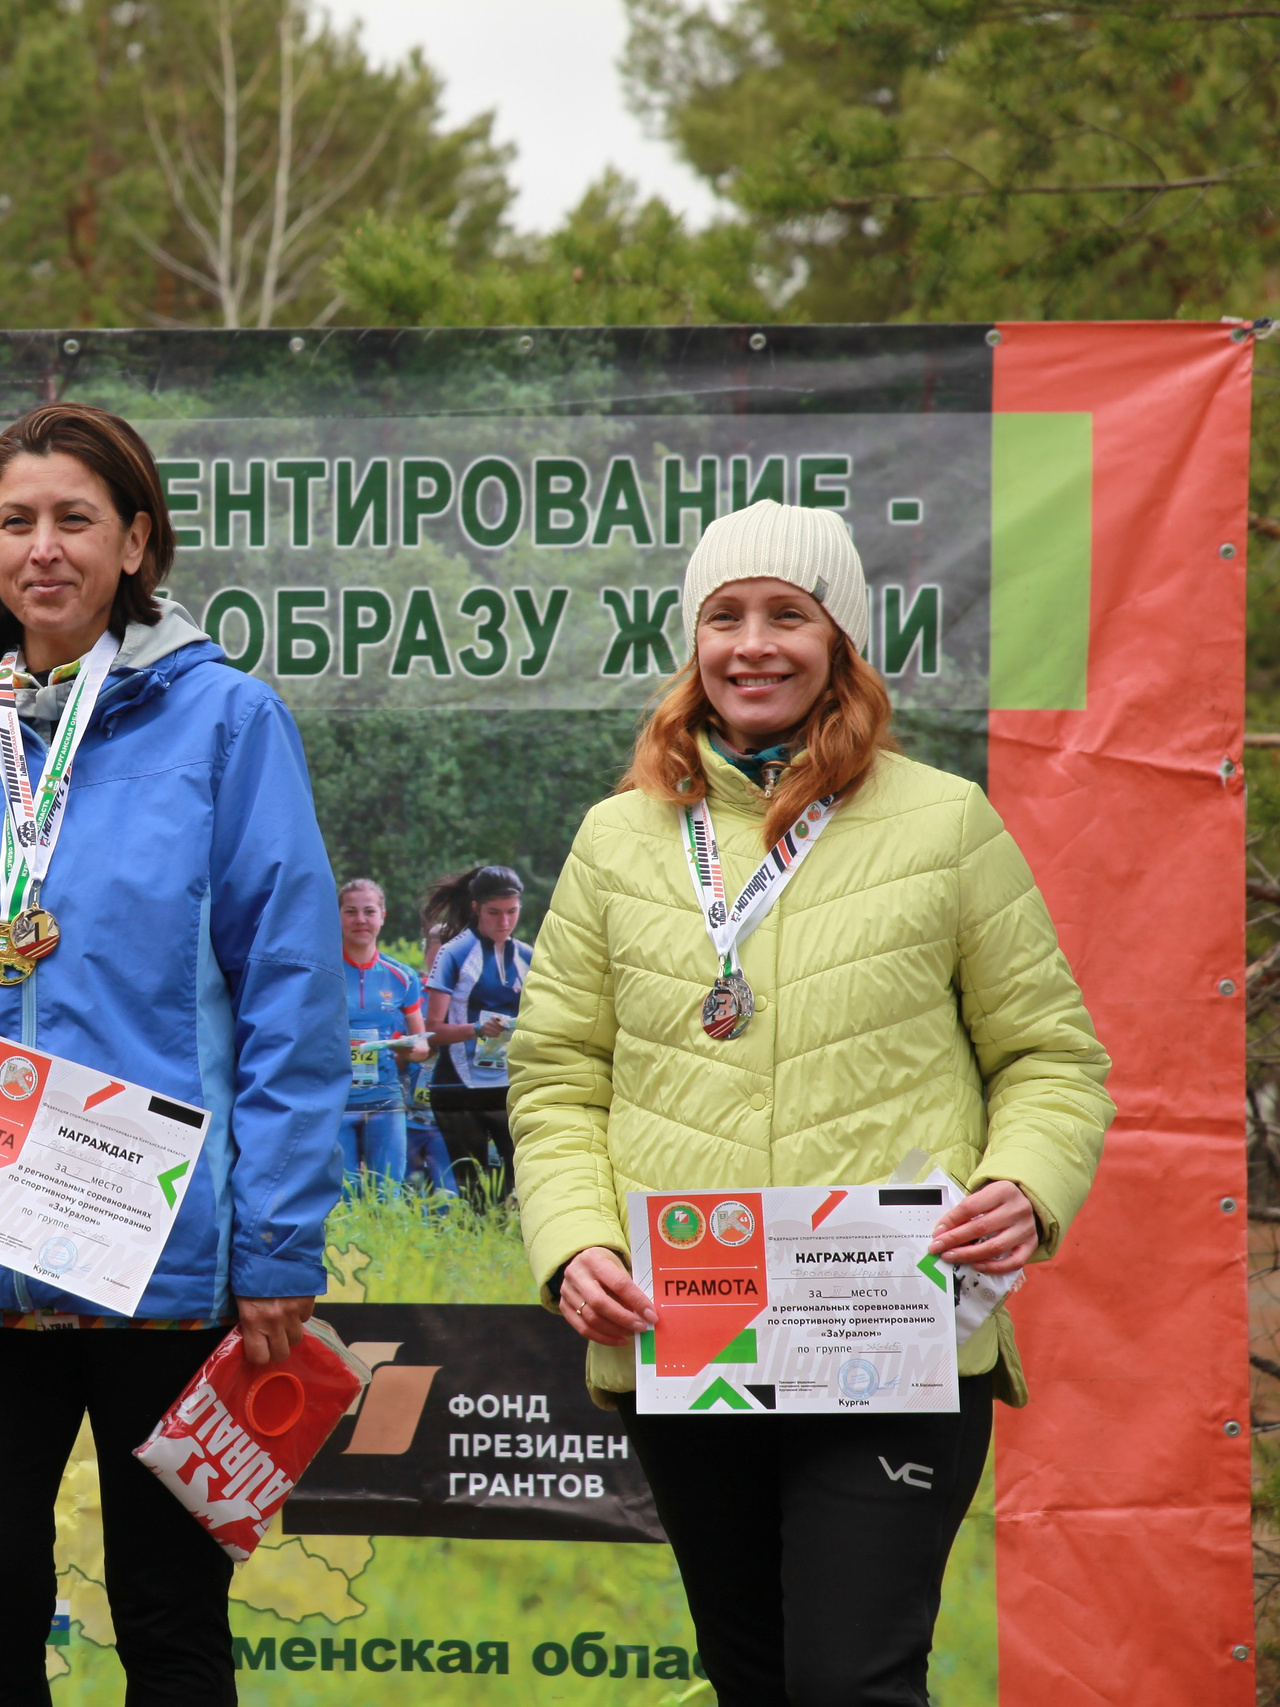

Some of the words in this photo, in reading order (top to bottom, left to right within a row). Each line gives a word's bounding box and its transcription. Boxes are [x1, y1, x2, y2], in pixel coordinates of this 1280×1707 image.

[202, 587, 569, 680] ОБРАЗУ
[350, 1049, 373, 1061] 512
[58, 1125, 144, 1165] НАГРАЖДАЕТ
[23, 1165, 86, 1195] региональных
[86, 1190, 153, 1220] соревнованиях
[90, 1176, 124, 1194] место
[8, 1173, 20, 1182] по
[20, 1179, 77, 1206] спортивному
[77, 1200, 152, 1233] ориентированию
[21, 1206, 33, 1216] по
[37, 1213, 70, 1231] группе
[48, 1202, 101, 1226] «ЗаУралом»
[795, 1251, 894, 1264] НАГРАЖДАЕТ
[33, 1263, 61, 1281] Курган
[664, 1278, 758, 1297] ГРАМОТА
[851, 1288, 888, 1298] место
[780, 1305, 851, 1314] региональных
[852, 1303, 930, 1312] соревнованиях
[781, 1317, 847, 1327] спортивному
[848, 1316, 936, 1326] ориентированию
[821, 1329, 882, 1340] «ЗаУралом»
[797, 1346, 810, 1354] по
[816, 1345, 852, 1355] группе
[449, 1394, 550, 1425] ФОНД
[838, 1398, 870, 1407] Курган
[449, 1433, 628, 1462] ПРЕЗИДЕН
[449, 1473, 605, 1500] ГРАНТОВ
[234, 1635, 510, 1676] менская
[531, 1631, 708, 1681] обла
